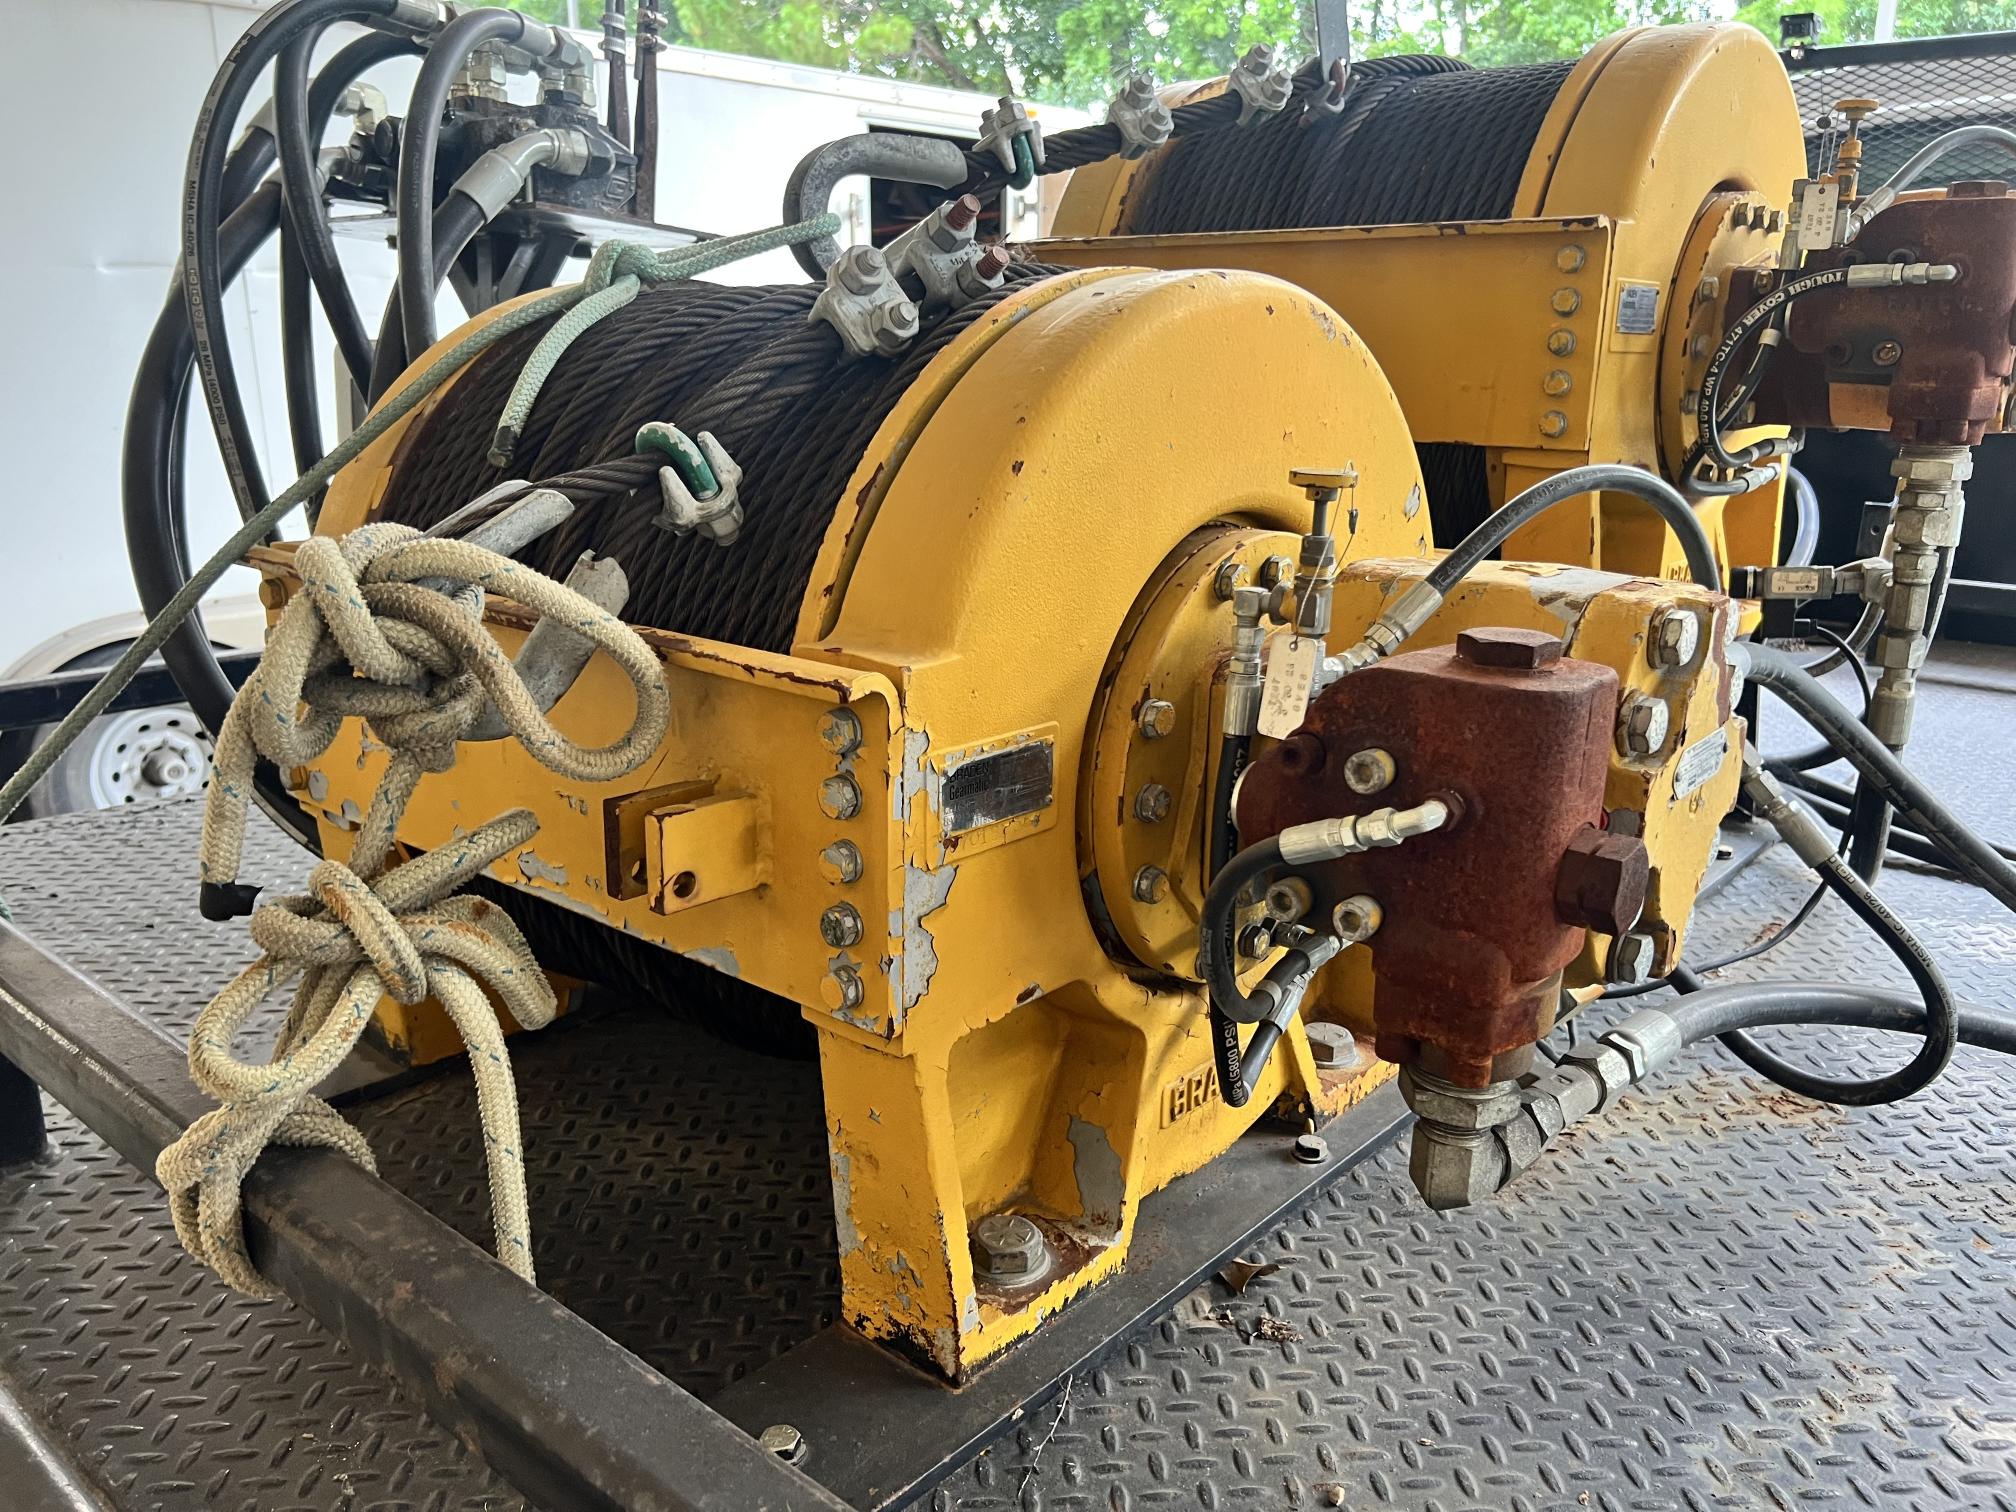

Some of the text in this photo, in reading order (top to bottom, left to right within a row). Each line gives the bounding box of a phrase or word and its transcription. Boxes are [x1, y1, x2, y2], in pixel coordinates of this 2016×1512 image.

[187, 180, 197, 211] MSHA
[1787, 271, 1845, 296] TOUGH
[1742, 291, 1785, 327] COVER
[202, 354, 213, 376] MPa
[1710, 326, 1743, 374] 471TC-4
[1704, 376, 1716, 396] WP
[949, 779, 989, 801] Gearmatic
[1863, 891, 1934, 968] MSHA IC-40/26
[1228, 1049, 1241, 1081] (5800
